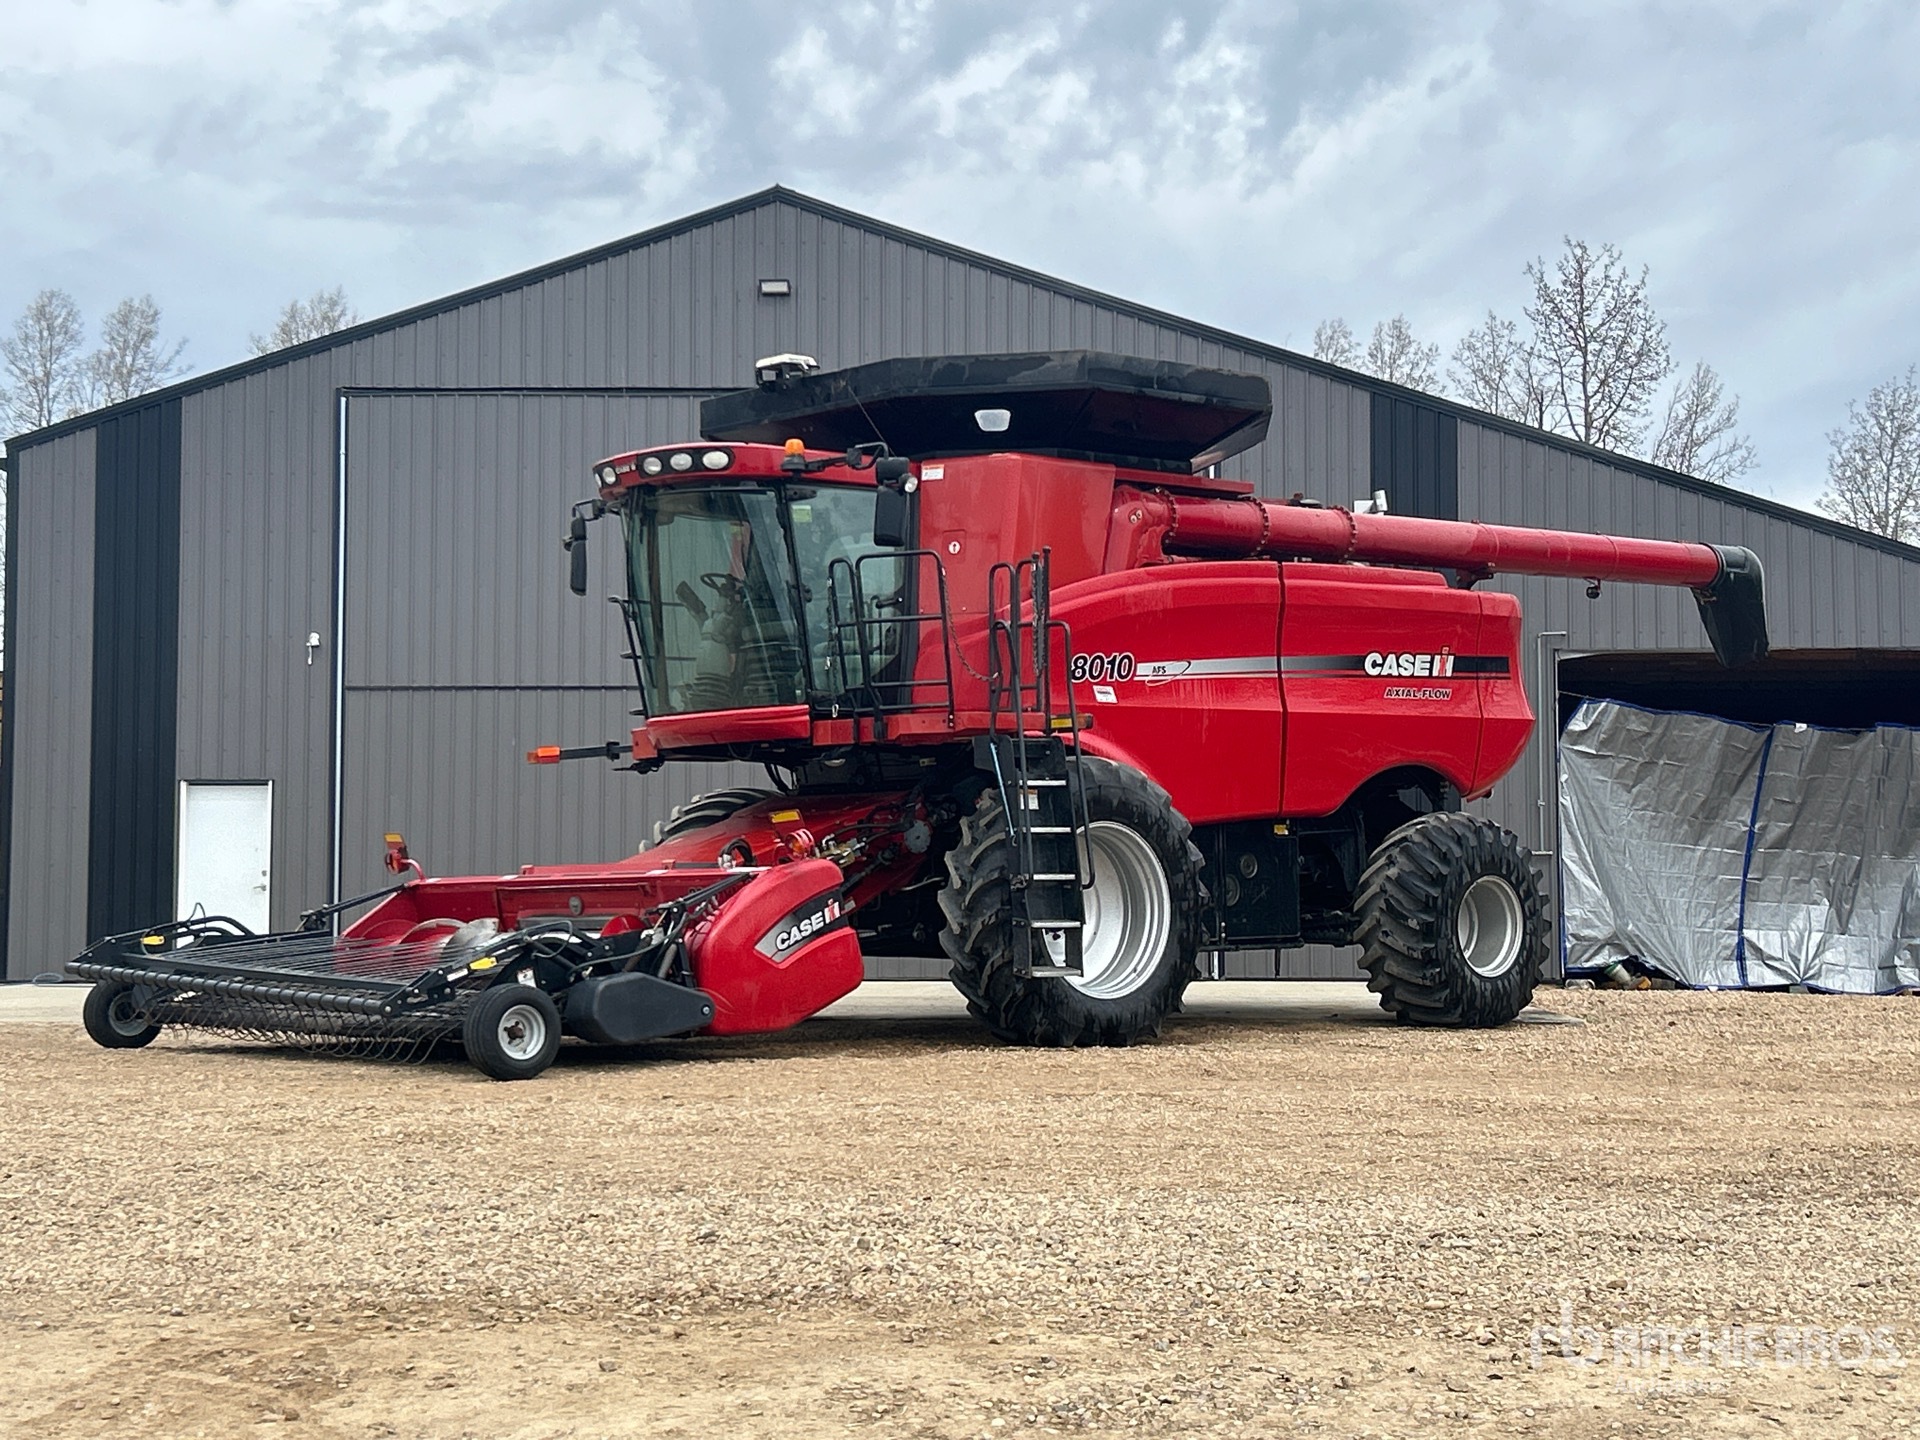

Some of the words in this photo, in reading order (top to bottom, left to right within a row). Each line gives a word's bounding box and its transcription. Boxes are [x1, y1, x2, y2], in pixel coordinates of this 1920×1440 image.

[1071, 652, 1135, 683] 8010
[1151, 665, 1167, 675] AFS
[1384, 687, 1452, 700] AXIAL-FLOW
